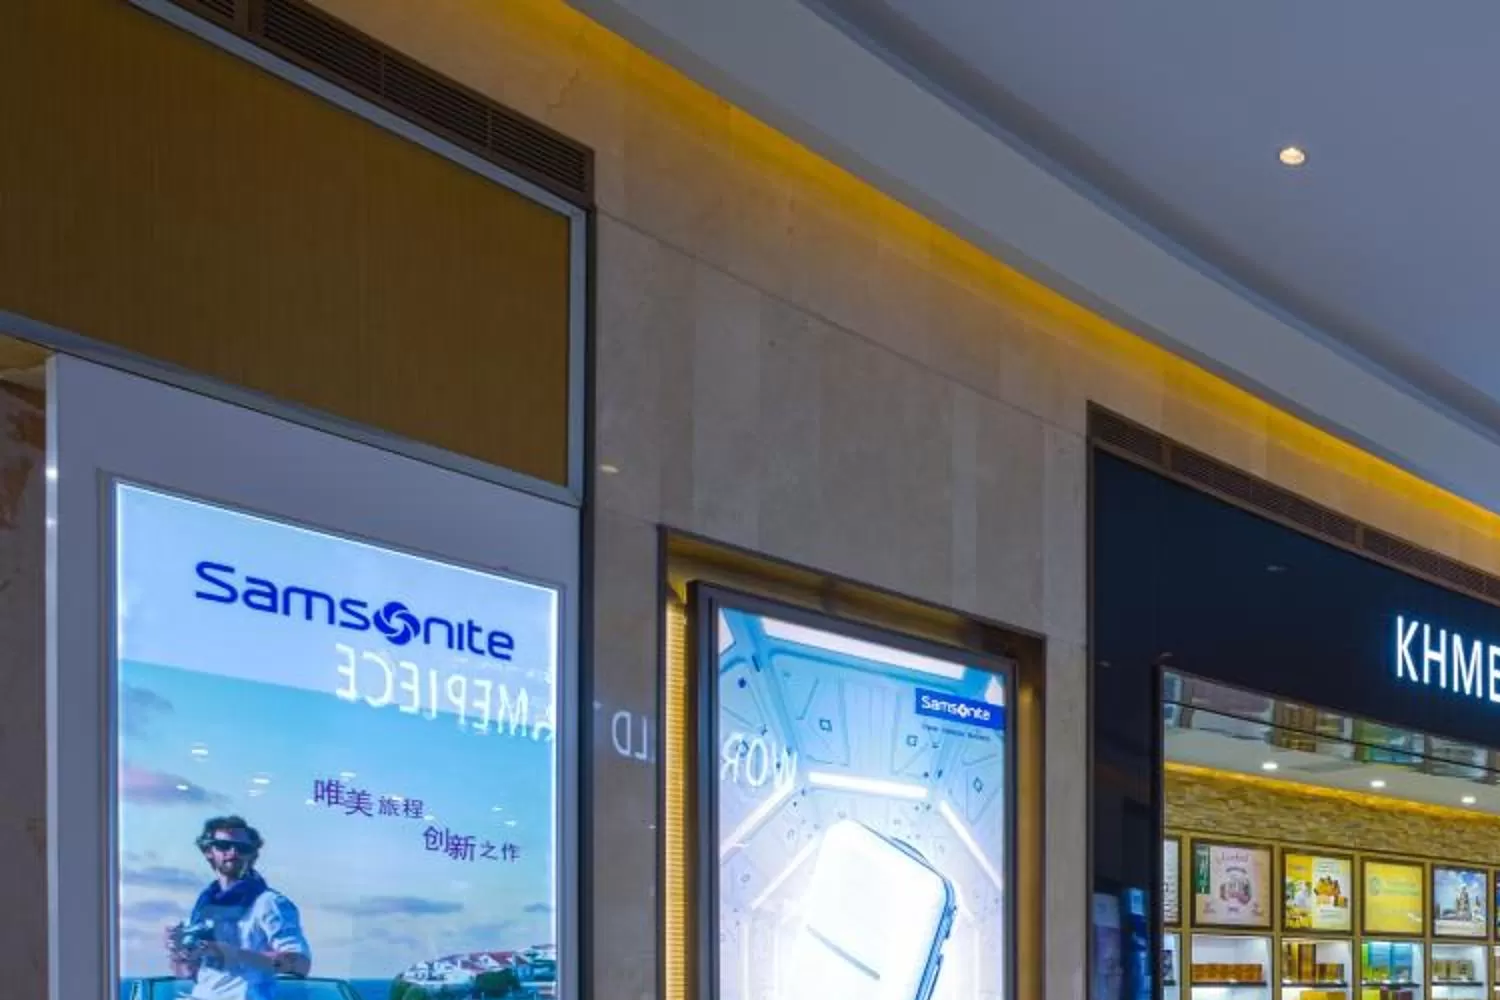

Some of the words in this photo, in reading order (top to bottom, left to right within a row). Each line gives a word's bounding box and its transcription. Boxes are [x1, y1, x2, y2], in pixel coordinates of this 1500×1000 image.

[195, 560, 515, 661] Samsonite
[422, 825, 521, 863] 创新之作
